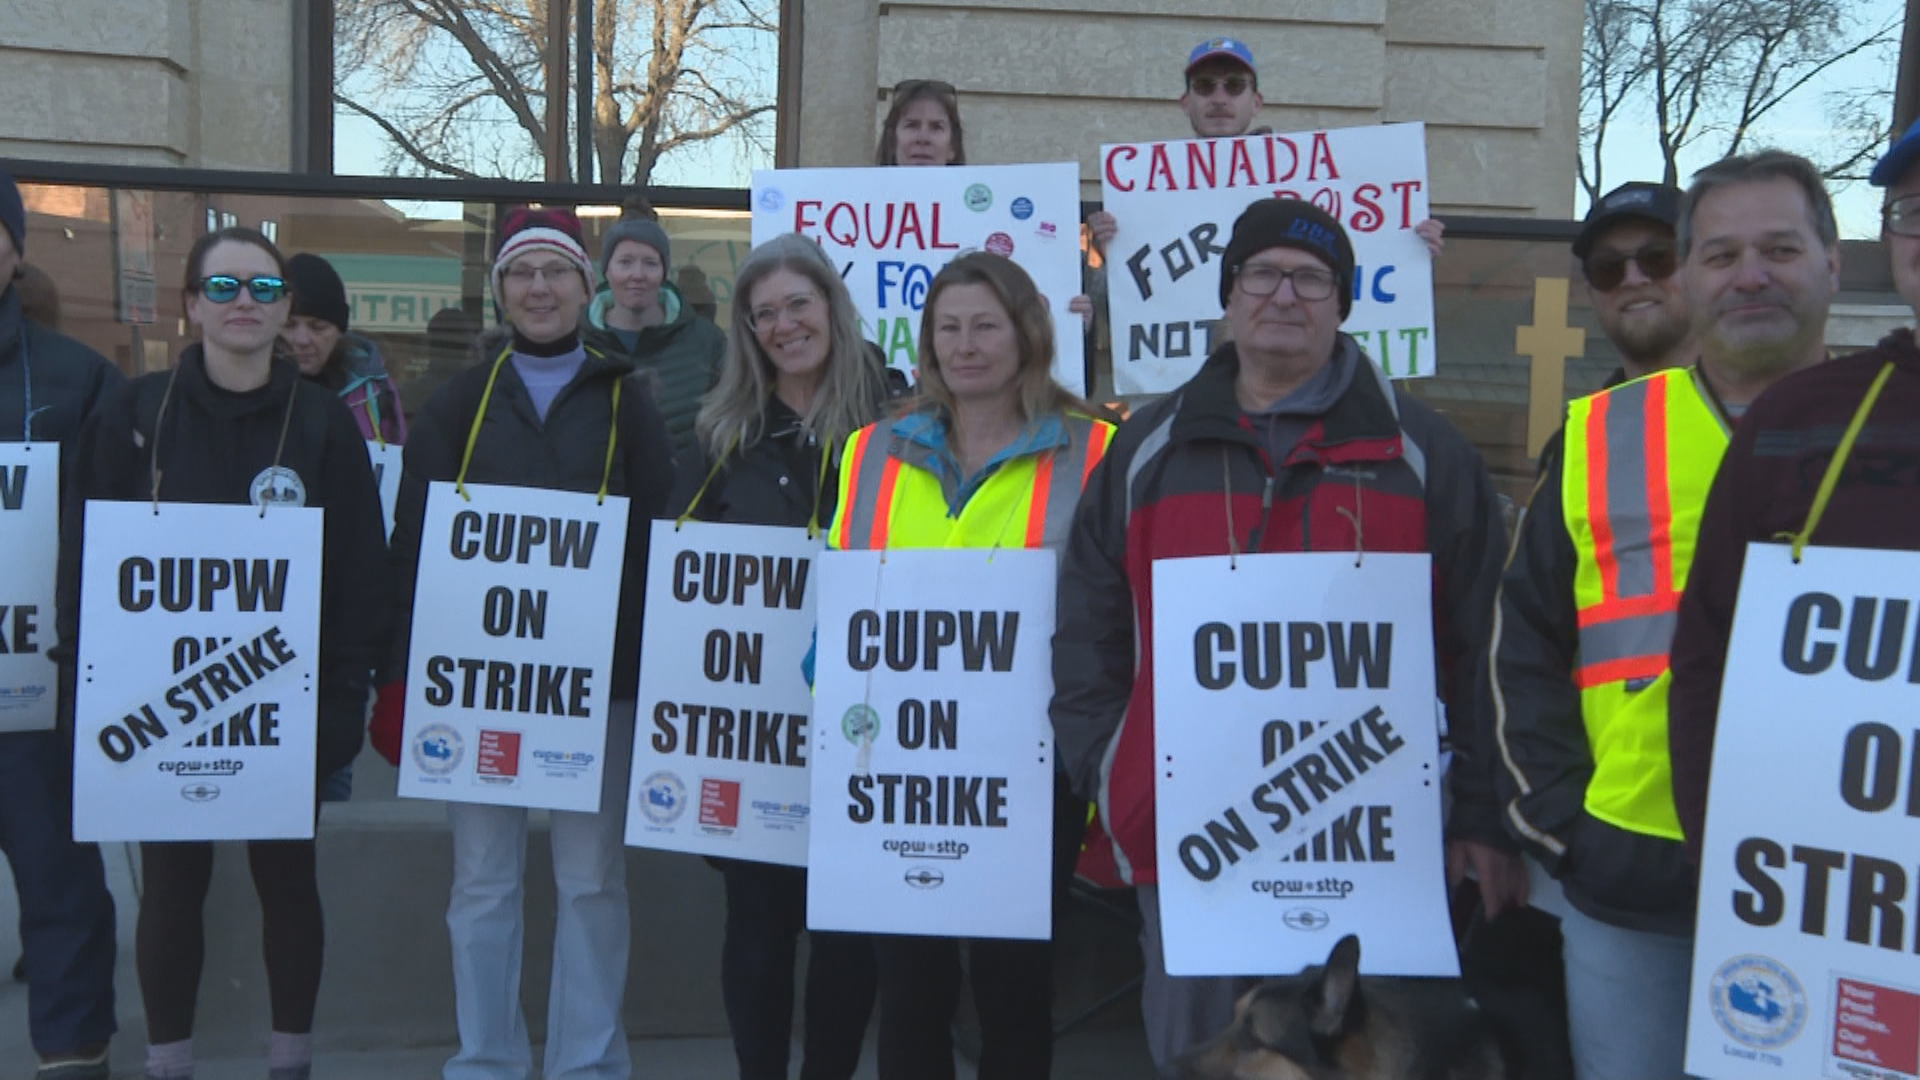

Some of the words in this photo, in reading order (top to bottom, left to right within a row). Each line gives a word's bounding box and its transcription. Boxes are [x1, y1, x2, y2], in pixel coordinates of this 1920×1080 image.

[1104, 131, 1341, 192] CANADA
[794, 200, 960, 250] EQUAL
[1272, 180, 1422, 233] OST
[876, 260, 952, 311] FO
[1125, 222, 1226, 302] FOR
[1128, 318, 1222, 363] NOT
[449, 510, 599, 570] CUPW
[118, 556, 290, 613] CUPW
[672, 550, 810, 610] CUPW
[482, 585, 549, 640] ON
[847, 609, 1020, 673] CUPW
[1780, 591, 1920, 685] CU
[703, 629, 764, 685] ON
[1193, 621, 1394, 691] CUPW
[98, 703, 169, 763] ON
[165, 625, 297, 735] STRIKE
[425, 655, 594, 719] STRIKE
[651, 700, 809, 768] STRIKE
[897, 699, 959, 750] ON
[157, 761, 202, 776] cupw
[212, 759, 244, 776] sttp
[1178, 807, 1260, 883] ON
[1251, 705, 1406, 834] STRIKE
[1839, 721, 1920, 819] O
[847, 773, 1009, 829] STRIKE
[882, 839, 926, 858] cupw
[937, 839, 970, 860] sttp
[1251, 879, 1304, 899] cupw
[1316, 877, 1354, 899] sttp
